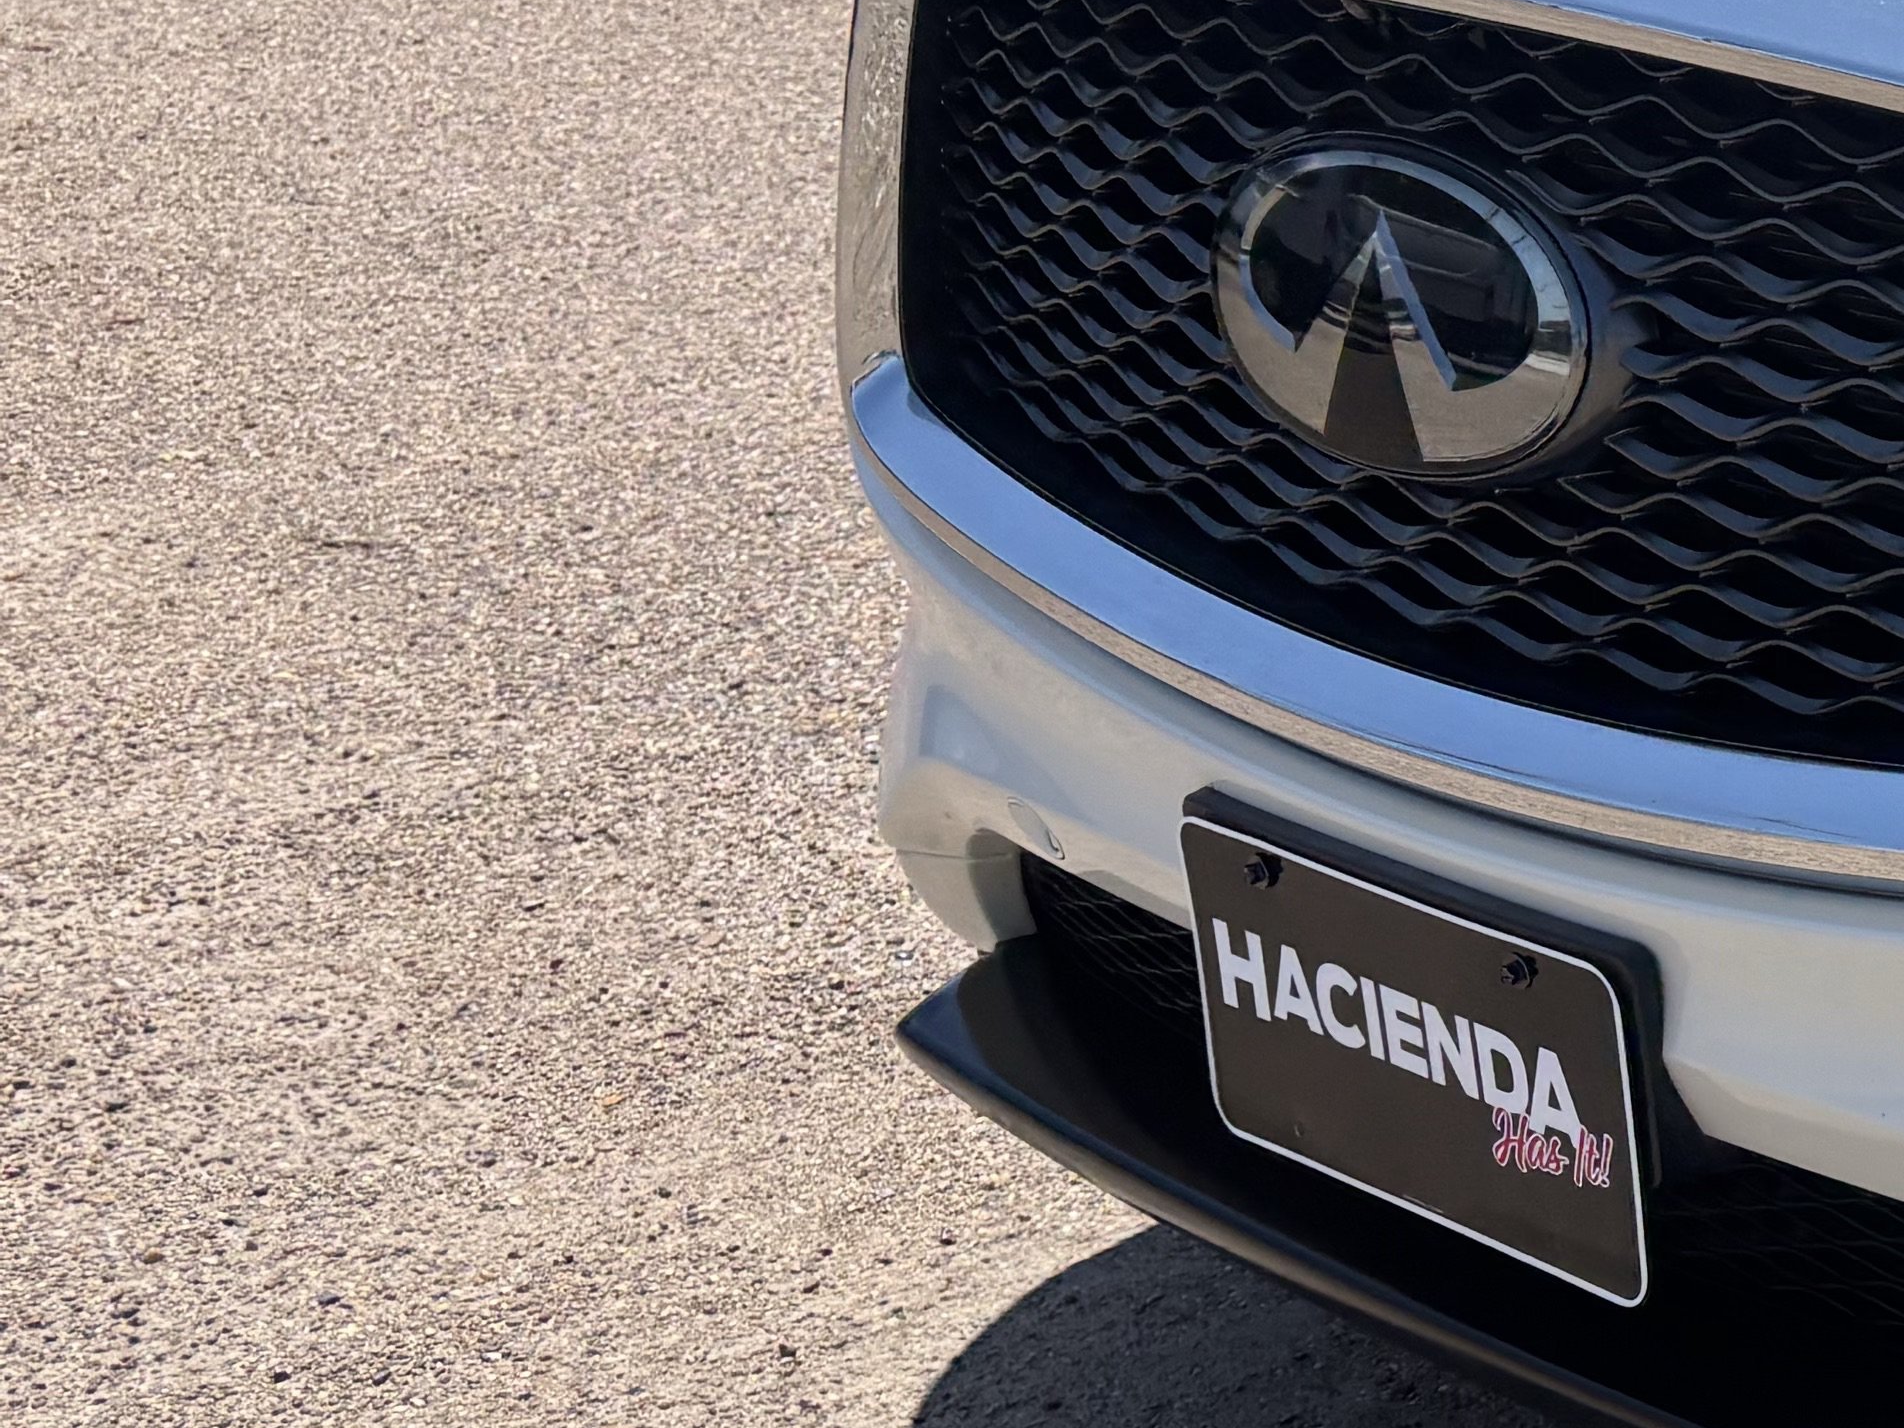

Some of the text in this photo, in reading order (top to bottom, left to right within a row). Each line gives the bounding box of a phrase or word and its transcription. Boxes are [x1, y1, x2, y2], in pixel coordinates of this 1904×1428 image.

[1211, 917, 1582, 1150] HACIENDA
[1492, 1107, 1614, 1188] Has It!
